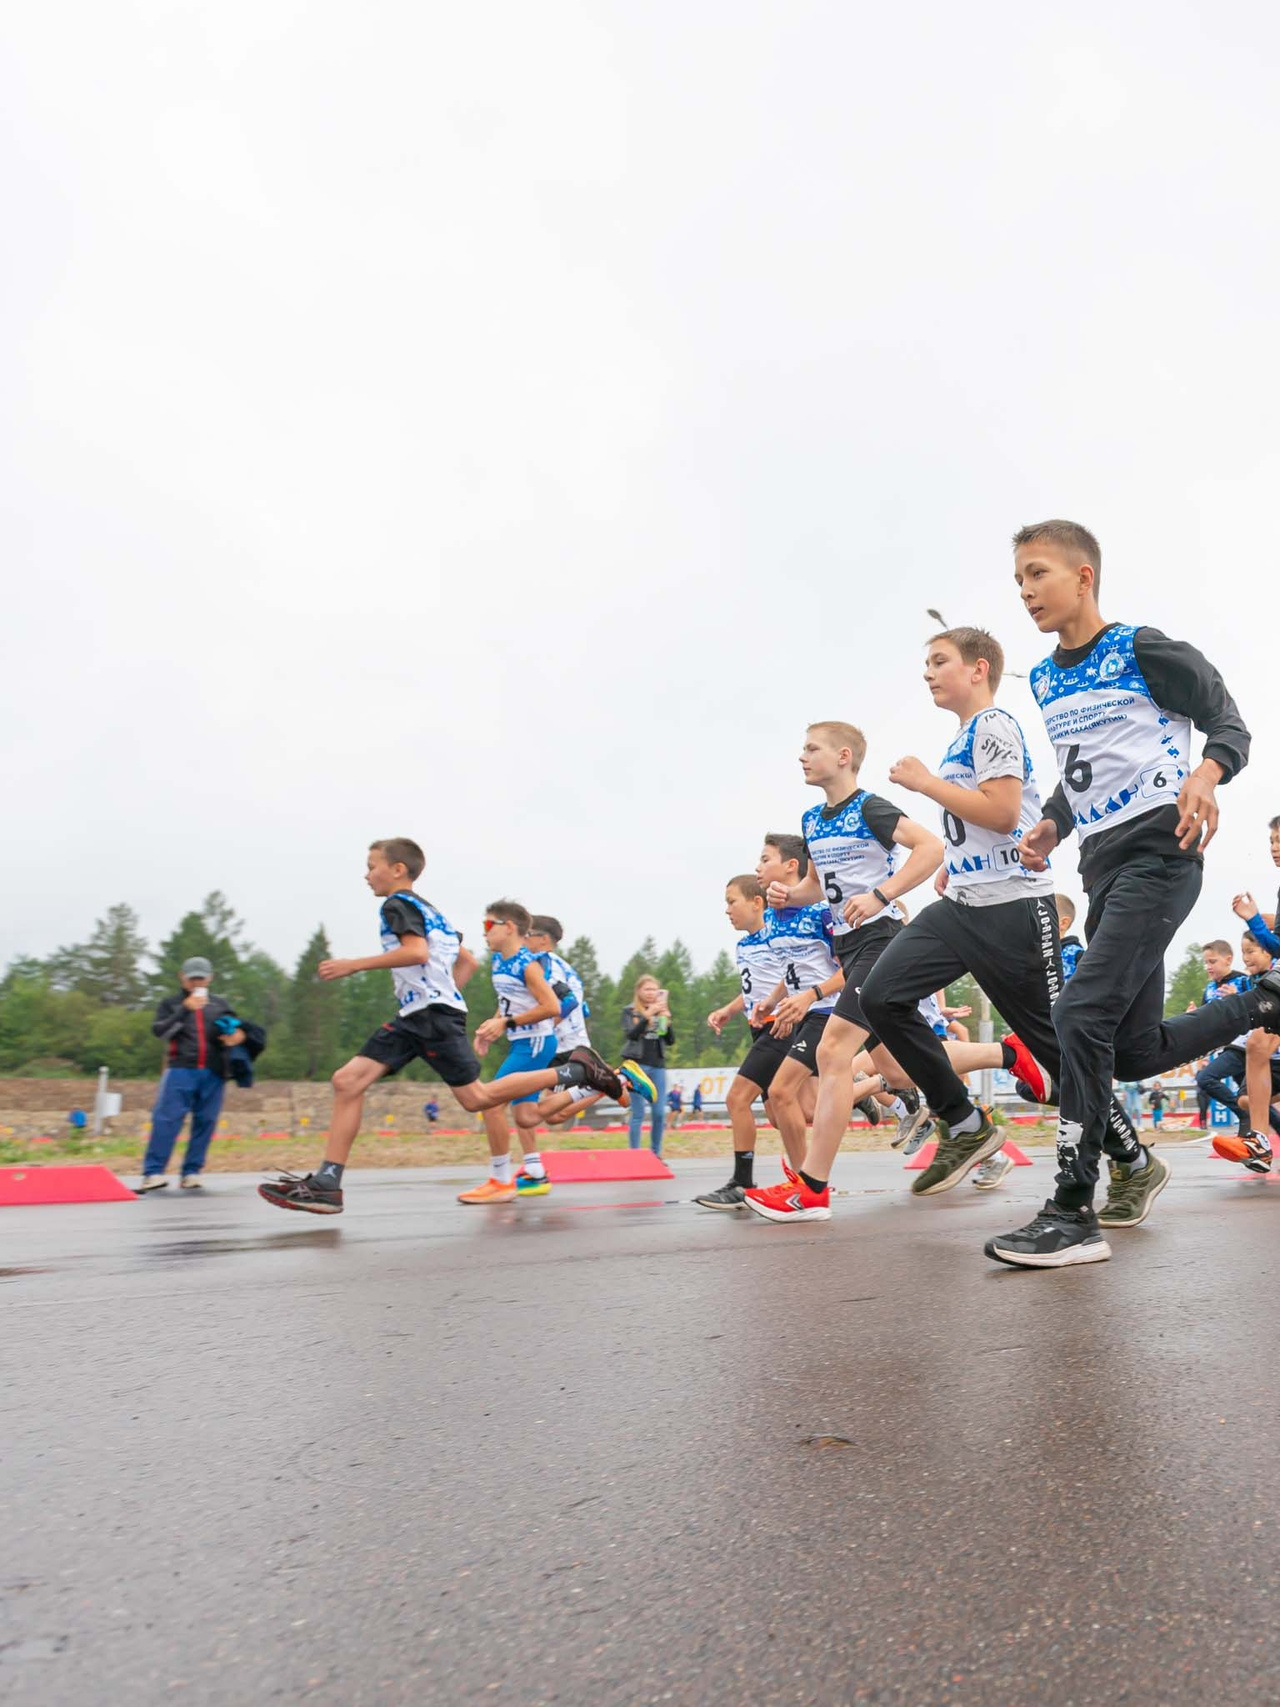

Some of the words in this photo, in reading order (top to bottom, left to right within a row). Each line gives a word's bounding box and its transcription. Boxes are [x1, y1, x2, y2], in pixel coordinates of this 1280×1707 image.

[1069, 708, 1079, 717] ПО
[1080, 696, 1135, 713] ФИЗИЧЕСКОЙ
[1072, 717, 1078, 725] И
[1079, 710, 1106, 724] СПОРТУ
[1064, 743, 1093, 793] 6
[1153, 771, 1168, 788] 6
[1000, 848, 1020, 865] 10
[823, 872, 844, 904] 5
[1038, 909, 1054, 958] JORDAN
[741, 967, 753, 995] 3
[785, 963, 800, 990] 4
